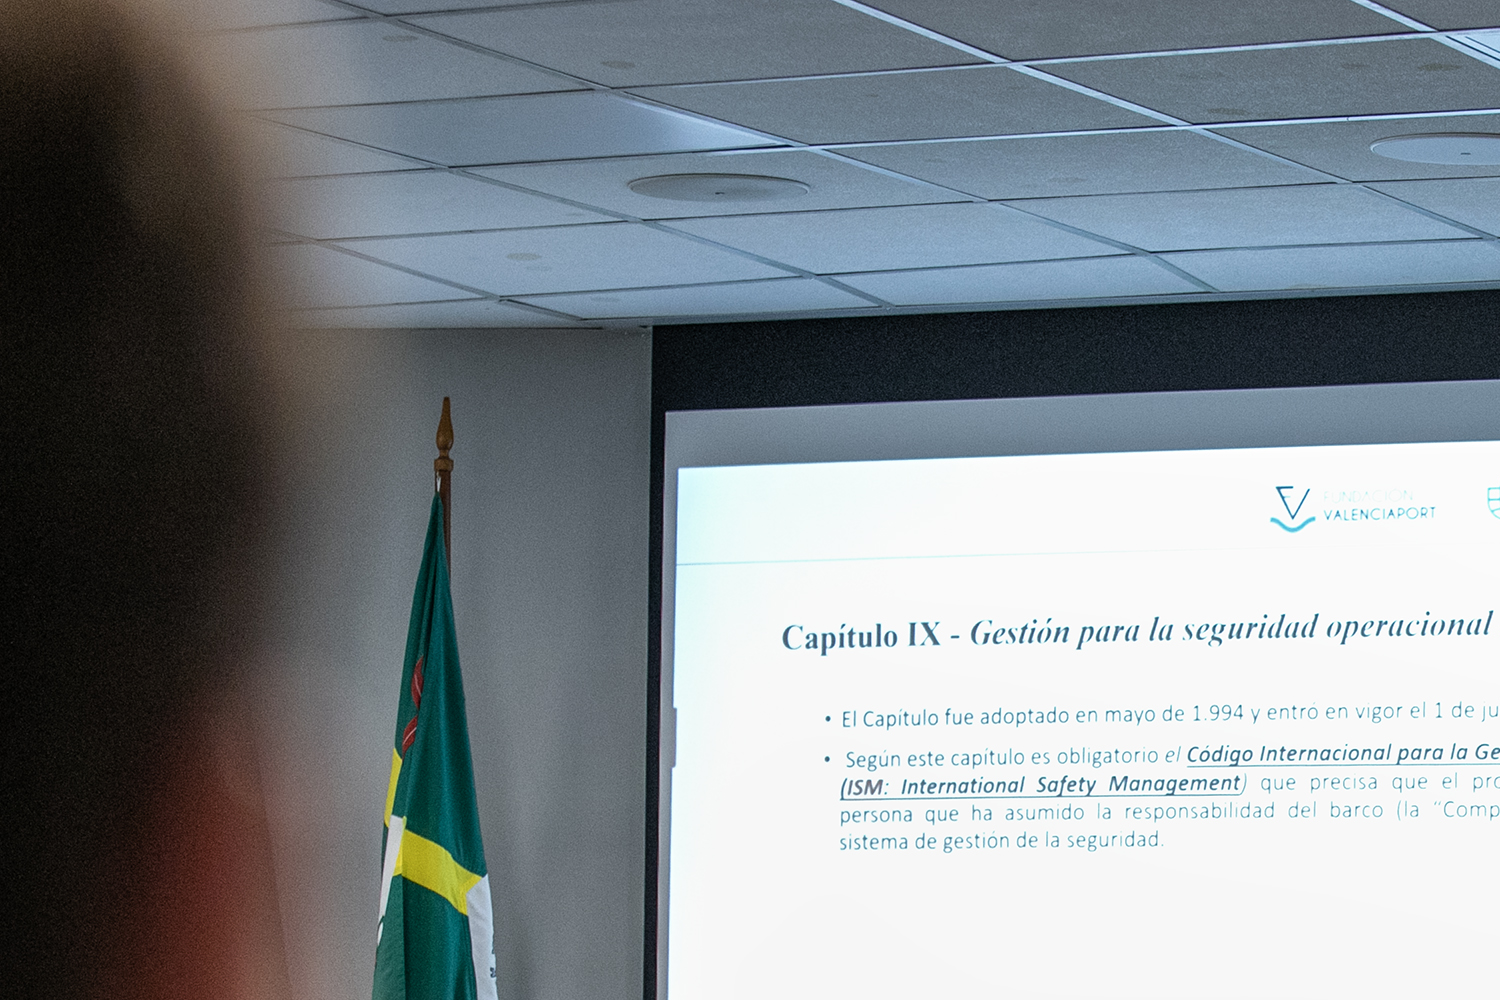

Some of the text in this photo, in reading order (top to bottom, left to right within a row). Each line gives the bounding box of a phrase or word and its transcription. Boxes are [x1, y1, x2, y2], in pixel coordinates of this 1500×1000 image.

[1324, 507, 1436, 521] VALENCIAPORT
[782, 623, 898, 656] Capítulo
[908, 621, 941, 646] IX
[971, 618, 1070, 645] Gestión
[1076, 625, 1140, 650] para
[1149, 616, 1174, 641] la
[1182, 613, 1319, 647] seguridad
[1326, 610, 1494, 645] operacional
[843, 710, 856, 728] El
[863, 708, 938, 731] Capítulo
[945, 708, 974, 725] fue
[980, 706, 1069, 728] adoptado
[1076, 710, 1098, 723] en
[1105, 709, 1155, 726] mayo
[1162, 705, 1184, 722] de
[1193, 704, 1243, 721] 1.994
[1251, 708, 1260, 724] y
[1267, 702, 1318, 720] entró
[1326, 707, 1348, 719] en
[1355, 703, 1403, 723] vigor
[1410, 701, 1425, 718] el
[1436, 702, 1442, 718] 1
[1452, 701, 1474, 718] de
[846, 749, 900, 772] Según
[907, 751, 944, 767] este
[951, 748, 1024, 770] capítulo
[1031, 752, 1050, 765] es
[1057, 747, 1158, 768] obligatorio
[1165, 746, 1181, 763] el
[1187, 745, 1253, 766] Código
[1260, 744, 1391, 764] Internacional
[1398, 747, 1444, 764] para
[1450, 743, 1468, 761] la
[902, 776, 1024, 796] International
[1036, 776, 1096, 796] Safety
[1109, 773, 1247, 795] Management)
[1261, 778, 1296, 794] que
[1311, 777, 1377, 794] precisa
[1392, 777, 1427, 793] que
[1442, 772, 1457, 789] el
[841, 810, 912, 827] persona
[925, 809, 959, 826] que
[972, 804, 992, 821] ha
[1005, 803, 1084, 821] asumido
[1098, 803, 1111, 820] la
[1125, 801, 1274, 823] responsabilidad
[1288, 801, 1316, 818] del
[1330, 801, 1383, 818] barco
[1397, 800, 1419, 821] (la
[840, 830, 1164, 853] sistema de gestión de la seguridad.
